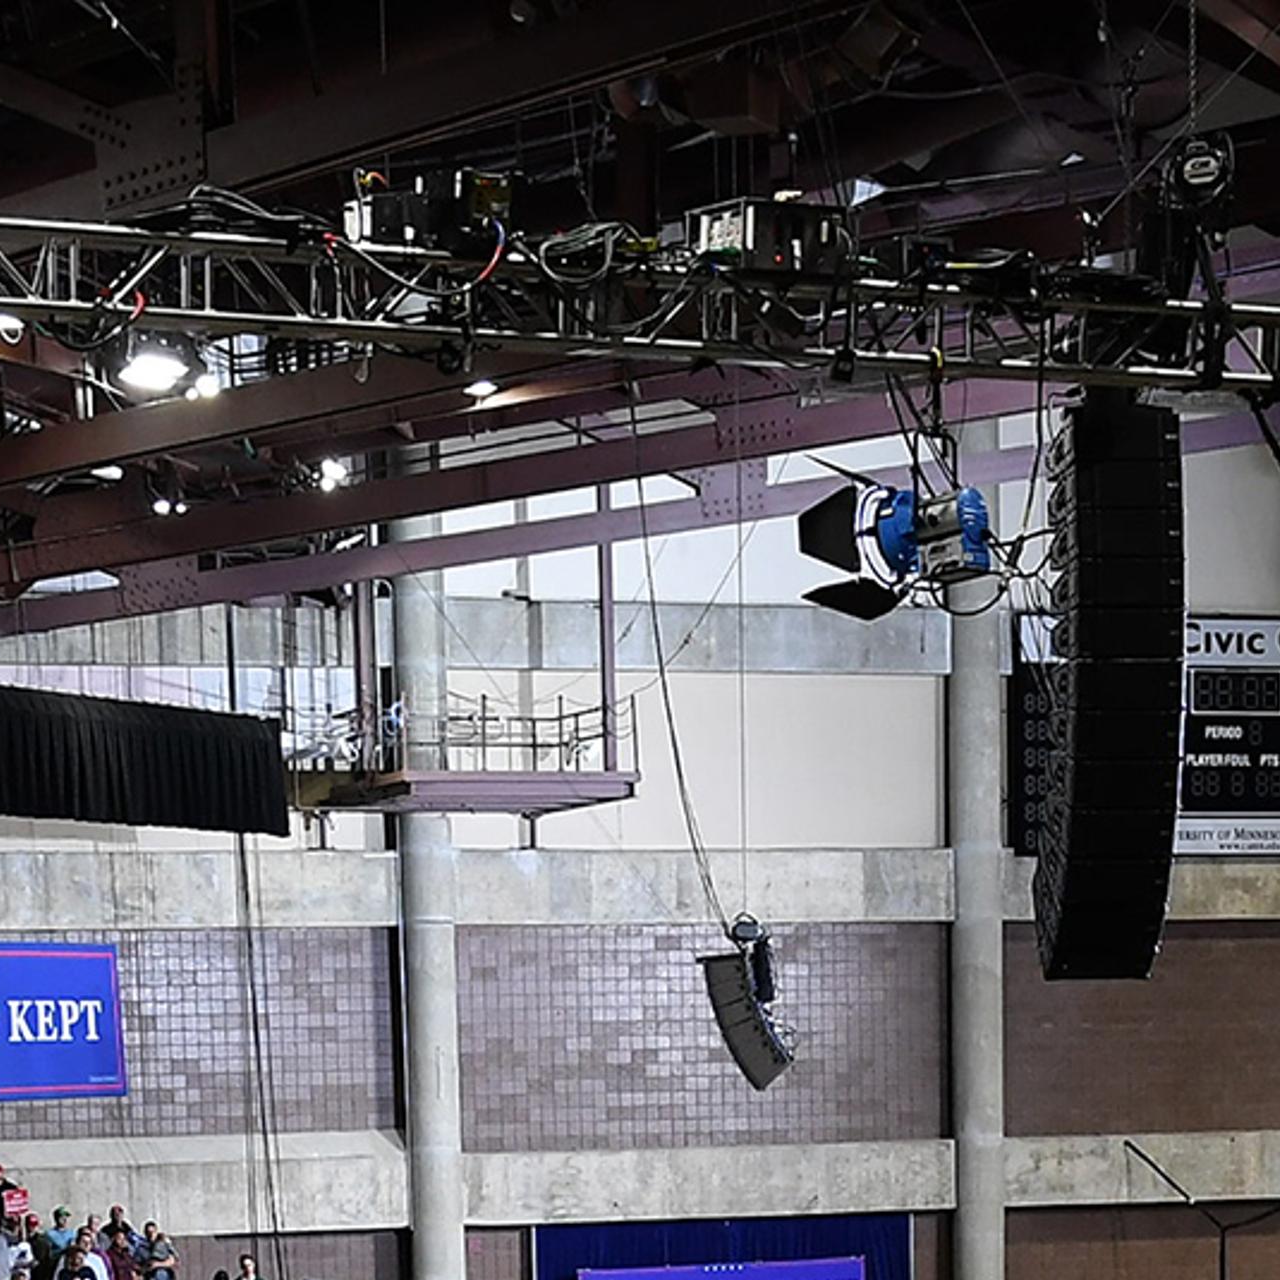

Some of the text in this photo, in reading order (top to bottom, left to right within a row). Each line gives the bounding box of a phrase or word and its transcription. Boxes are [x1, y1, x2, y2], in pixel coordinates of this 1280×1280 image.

[1186, 622, 1265, 654] Civic
[1205, 726, 1243, 739] PERIOD
[1186, 754, 1222, 767] PLAYER
[1222, 754, 1251, 767] FOUL
[1260, 754, 1280, 767] PTS
[6, 1000, 102, 1042] KEPT
